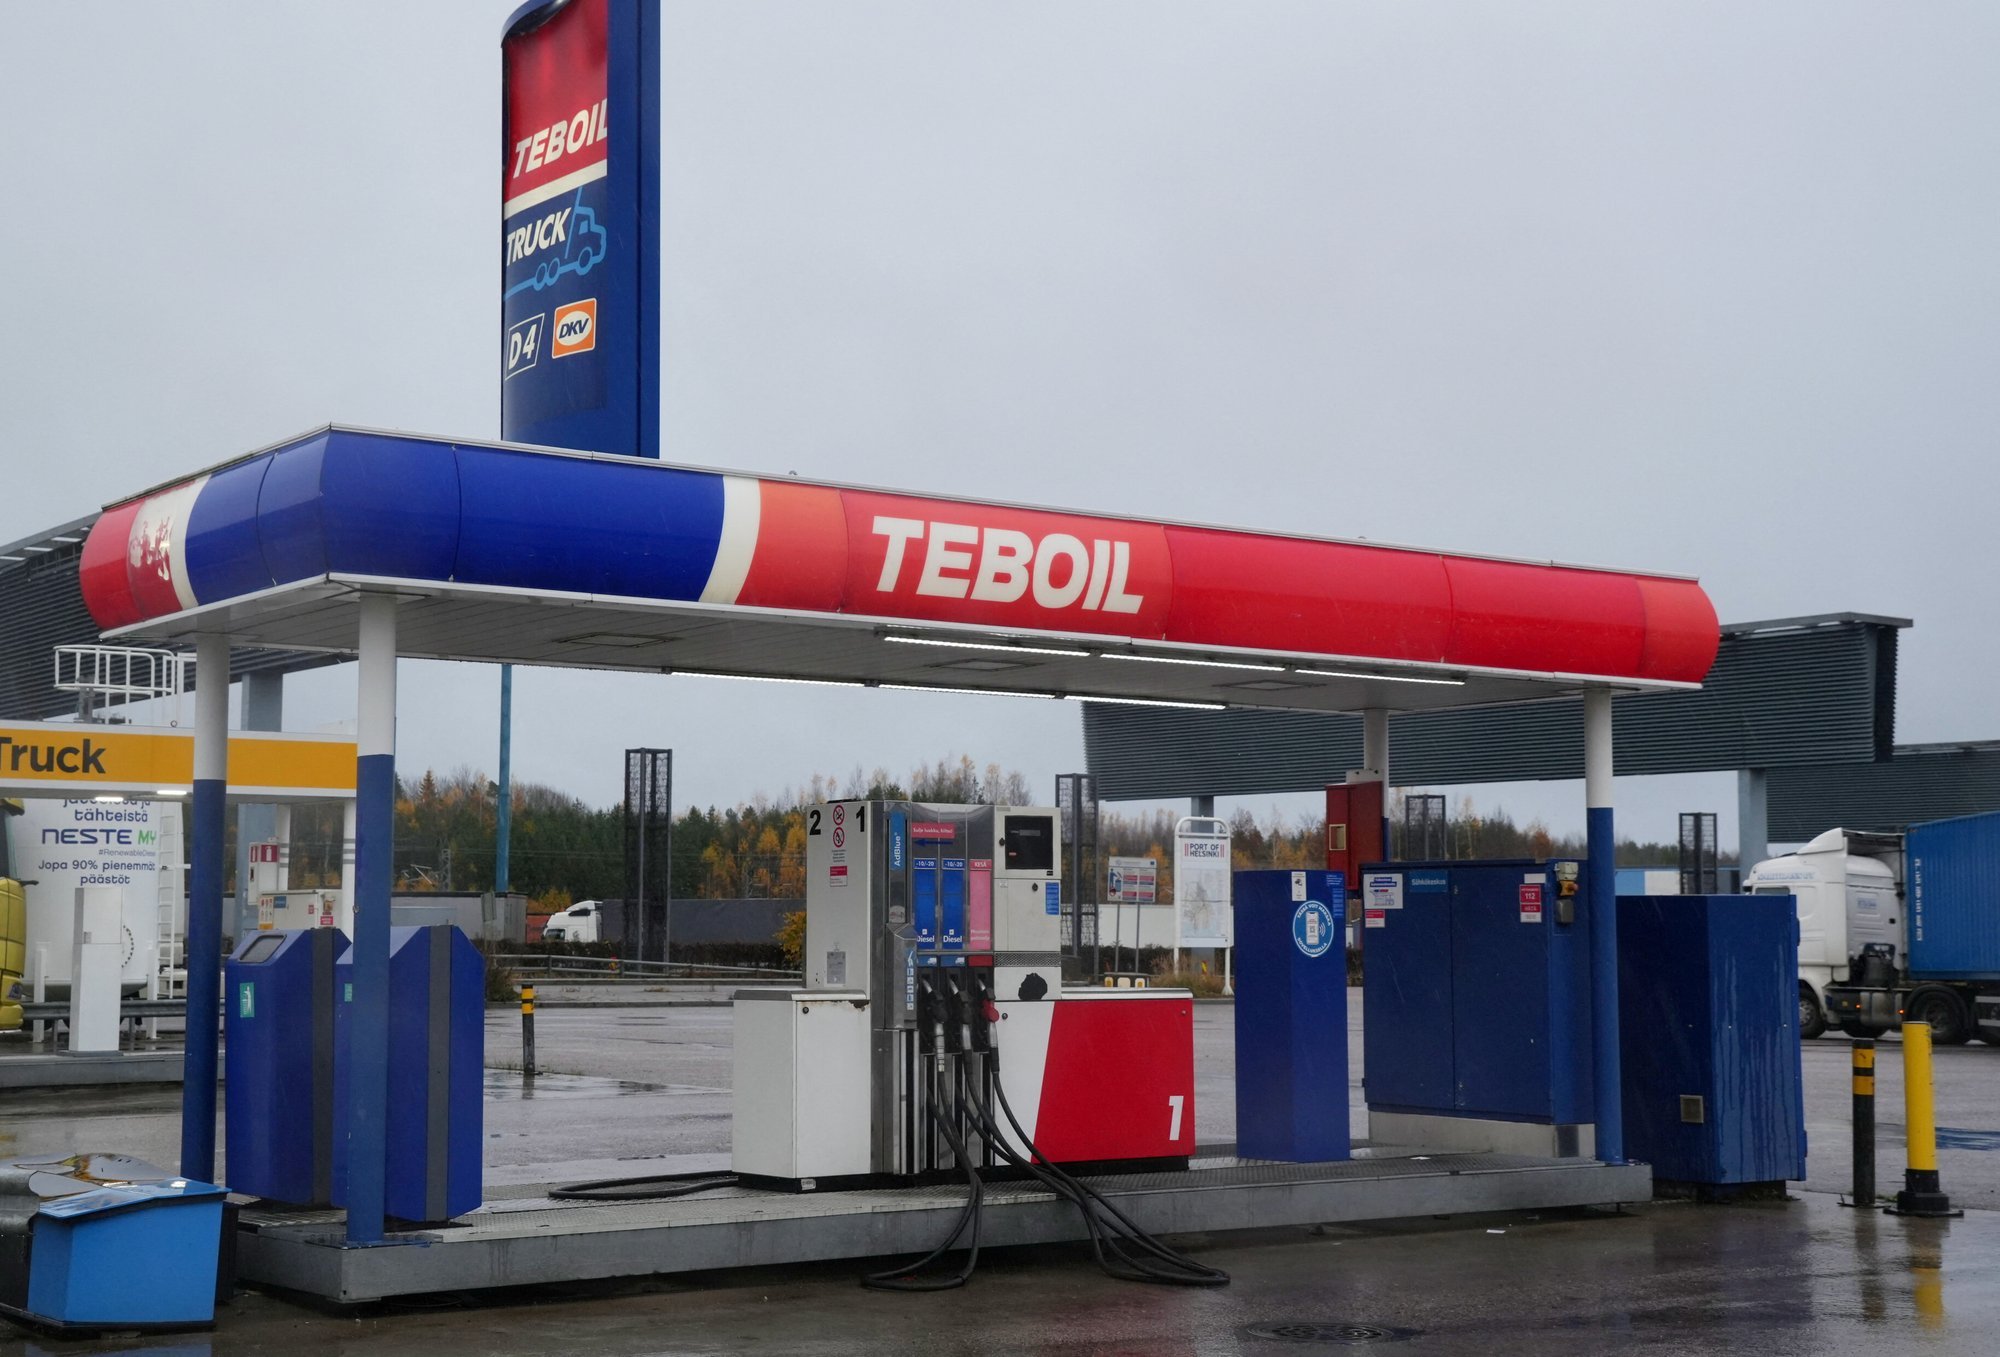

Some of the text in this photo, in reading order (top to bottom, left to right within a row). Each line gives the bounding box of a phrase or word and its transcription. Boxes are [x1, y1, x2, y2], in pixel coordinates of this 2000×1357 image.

[513, 98, 608, 180] TEBOIL
[506, 206, 572, 267] TRUCK
[558, 317, 589, 339] DKV
[508, 323, 537, 370] D4
[872, 515, 1144, 614] TEBOIL
[74, 808, 148, 822] tähteistä
[809, 809, 822, 836] 2
[856, 805, 865, 833] 1
[42, 828, 133, 845] NESTE
[1189, 843, 1220, 851] PORT OF
[1189, 850, 1220, 858] HELSINKI
[38, 860, 68, 872] Jopa
[72, 859, 98, 870] 90%
[80, 874, 131, 886] päästöt
[943, 935, 963, 943] Diesel
[1168, 1095, 1184, 1141] 1
